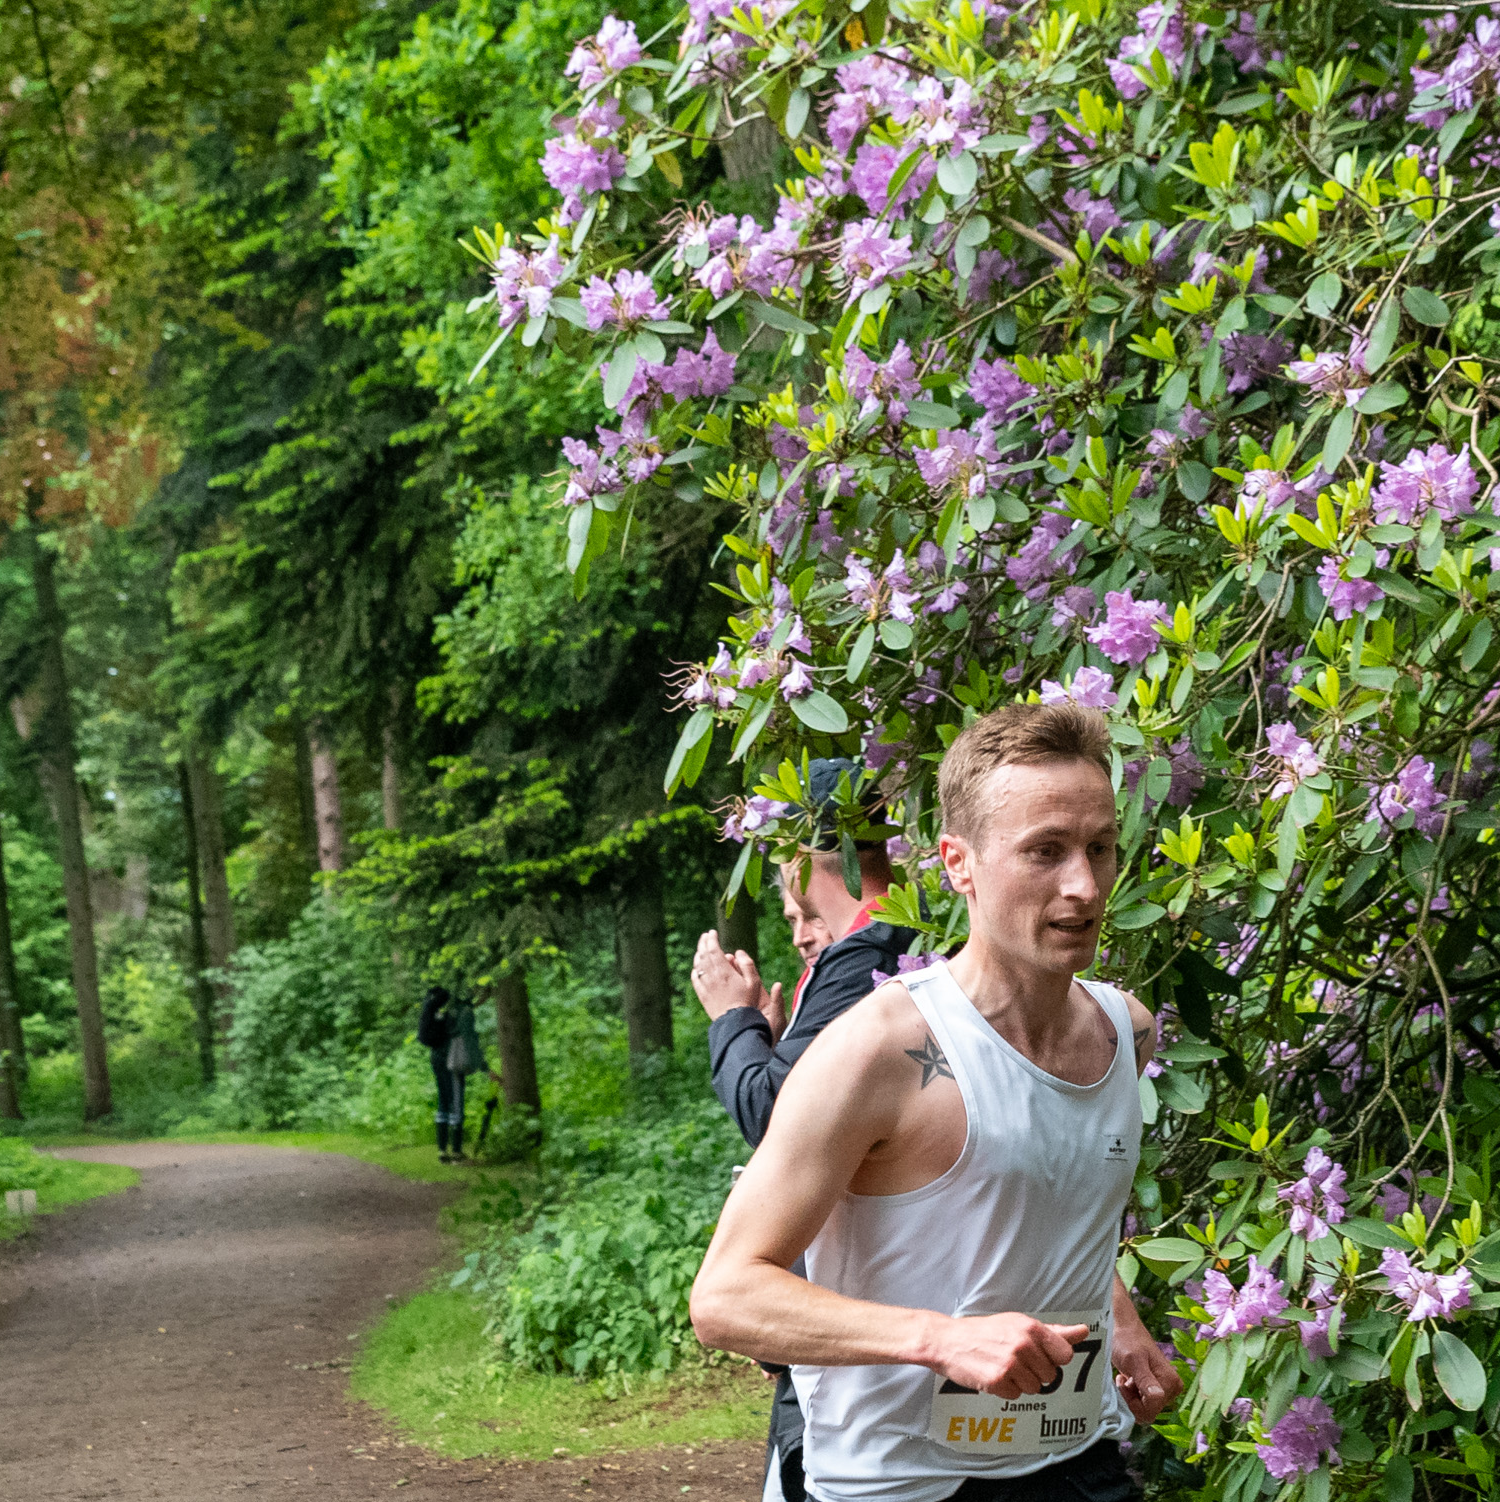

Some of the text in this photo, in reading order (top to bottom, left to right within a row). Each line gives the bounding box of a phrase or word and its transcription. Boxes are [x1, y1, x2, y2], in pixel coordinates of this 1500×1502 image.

[1001, 1401, 1047, 1412] Jannes
[946, 1413, 1087, 1443] EWE bruns
